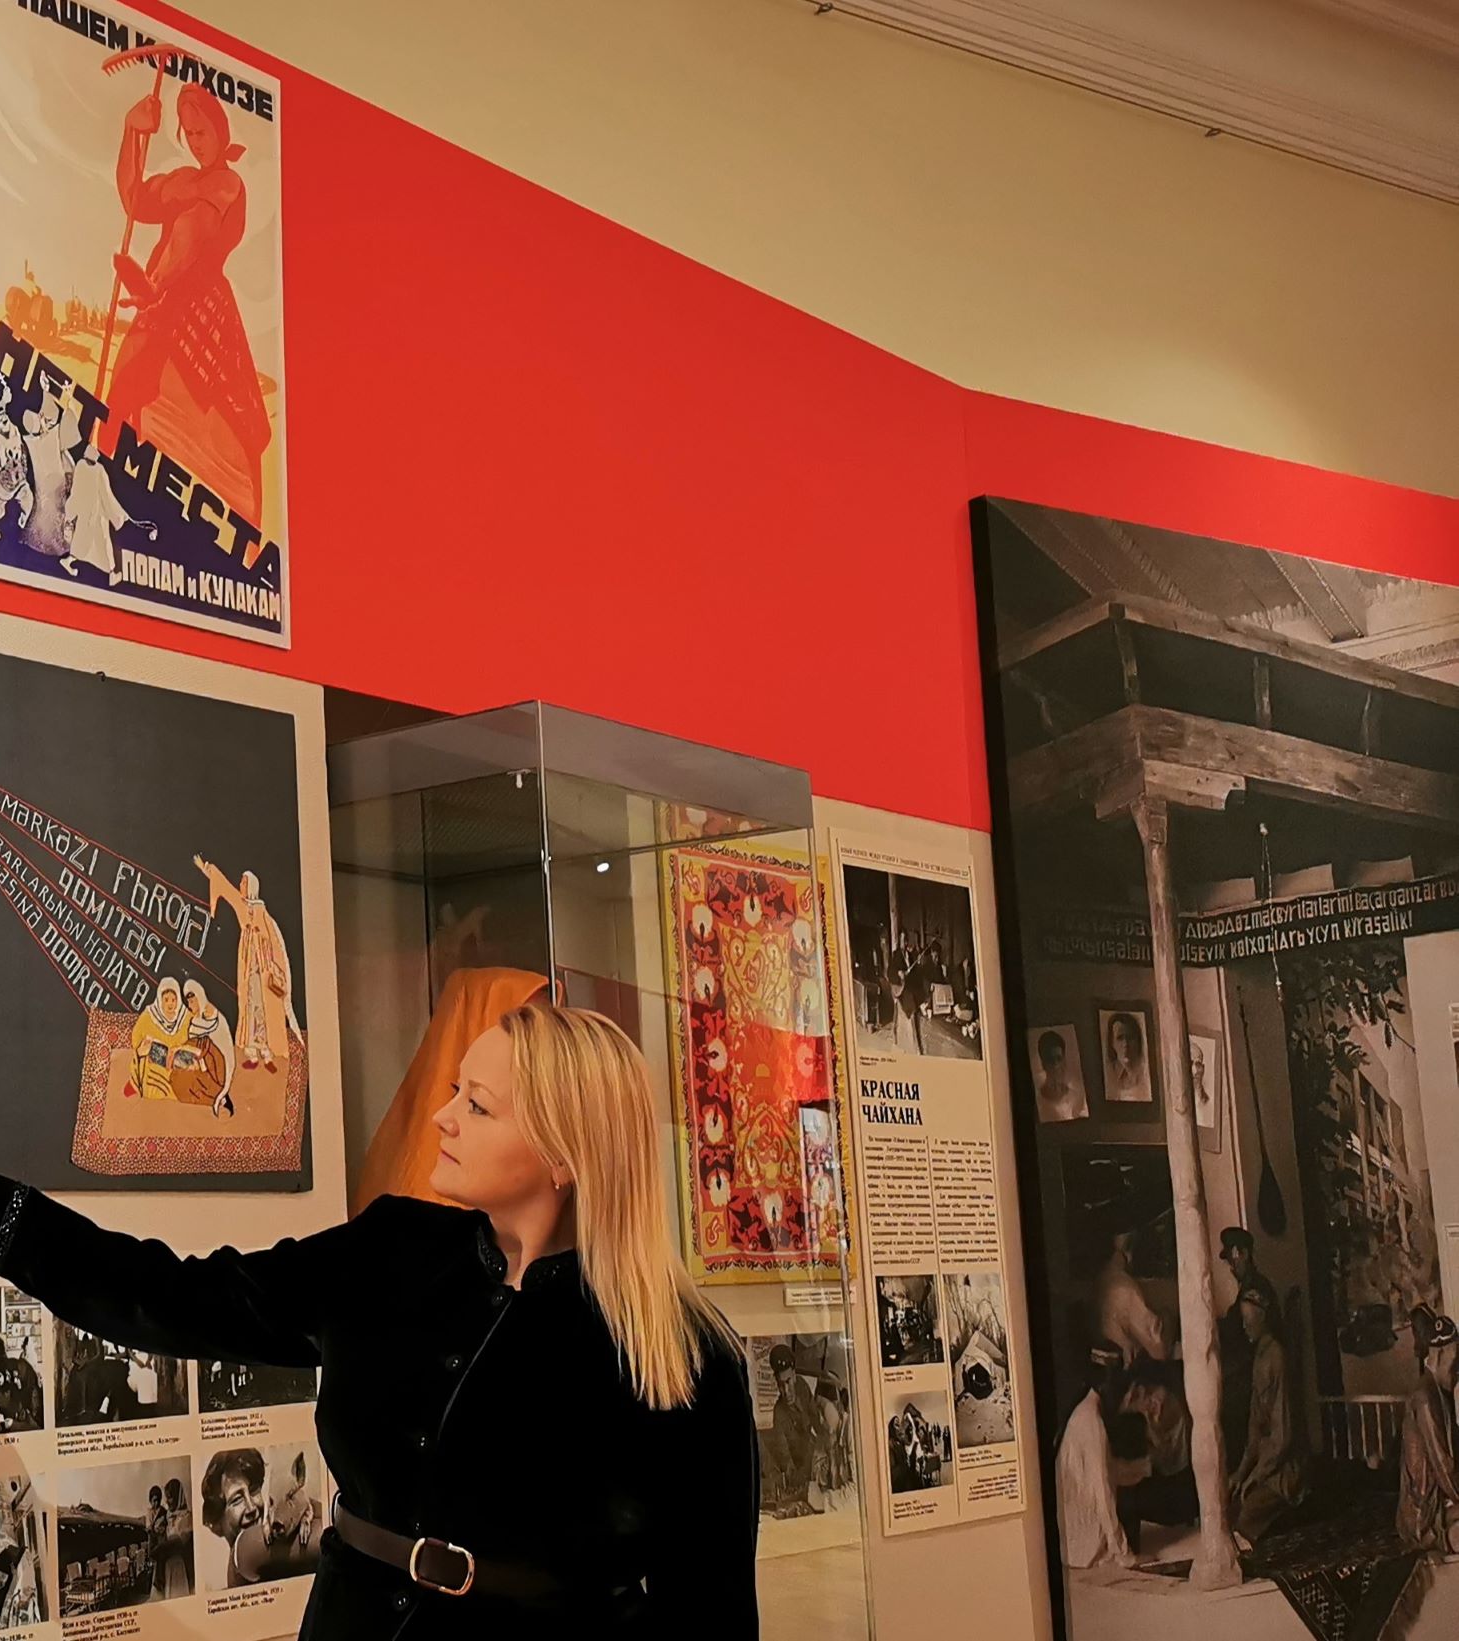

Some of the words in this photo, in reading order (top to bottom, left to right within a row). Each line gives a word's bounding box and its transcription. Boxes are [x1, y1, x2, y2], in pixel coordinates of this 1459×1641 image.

[113, 421, 282, 592] МЕСТА
[121, 549, 185, 597] ПОПАМ
[200, 571, 281, 622] КУЛАКАМ
[860, 1079, 920, 1101] КРАСНАЯ
[861, 1102, 923, 1126] ЧАЙХАНА
